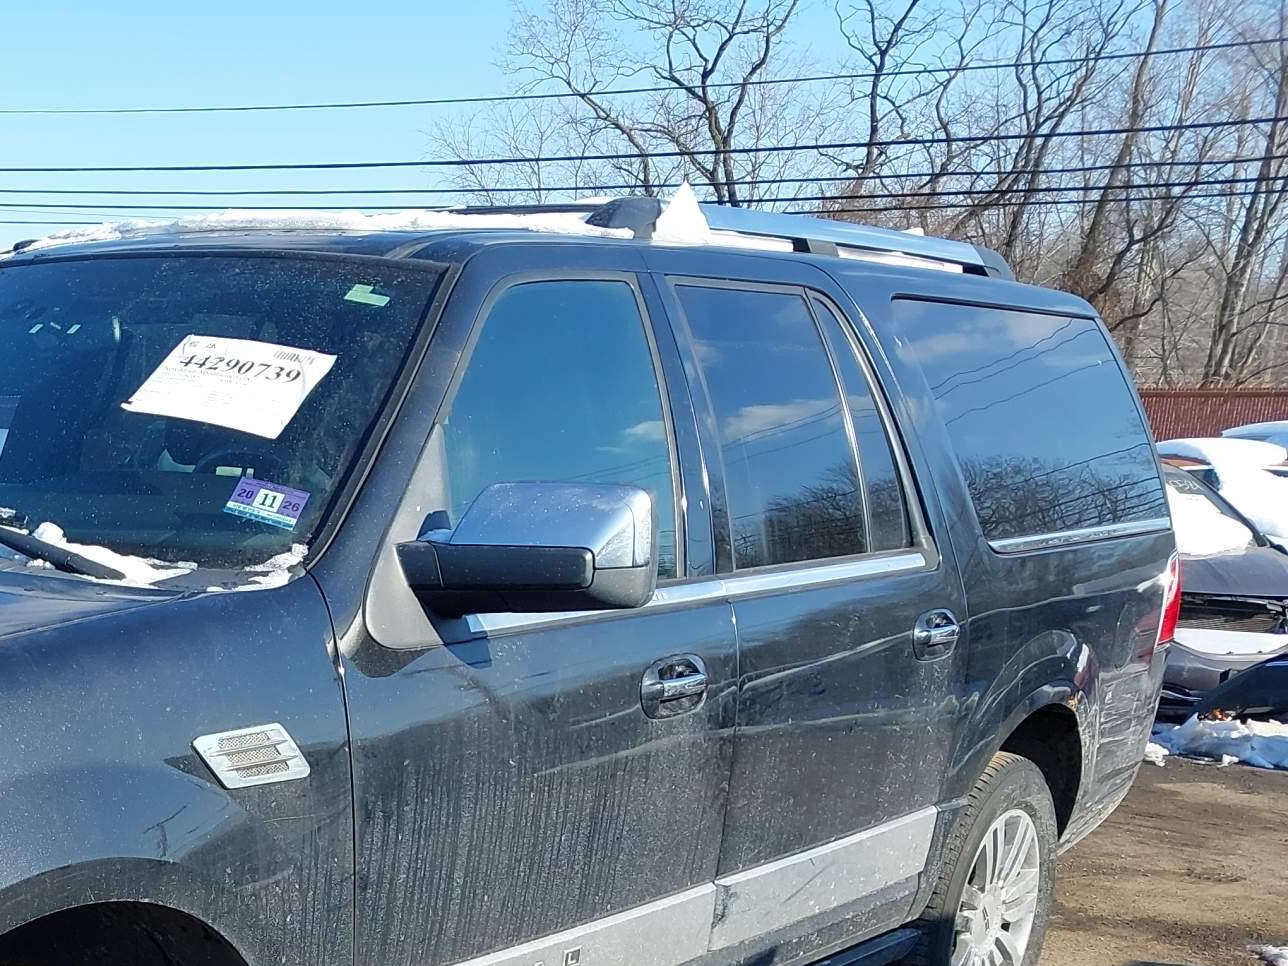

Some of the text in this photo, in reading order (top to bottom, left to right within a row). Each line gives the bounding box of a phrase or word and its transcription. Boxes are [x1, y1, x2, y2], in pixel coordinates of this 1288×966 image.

[179, 354, 301, 384] 44290739
[237, 488, 254, 499] 20
[259, 493, 278, 509] 11
[282, 500, 300, 512] 26
